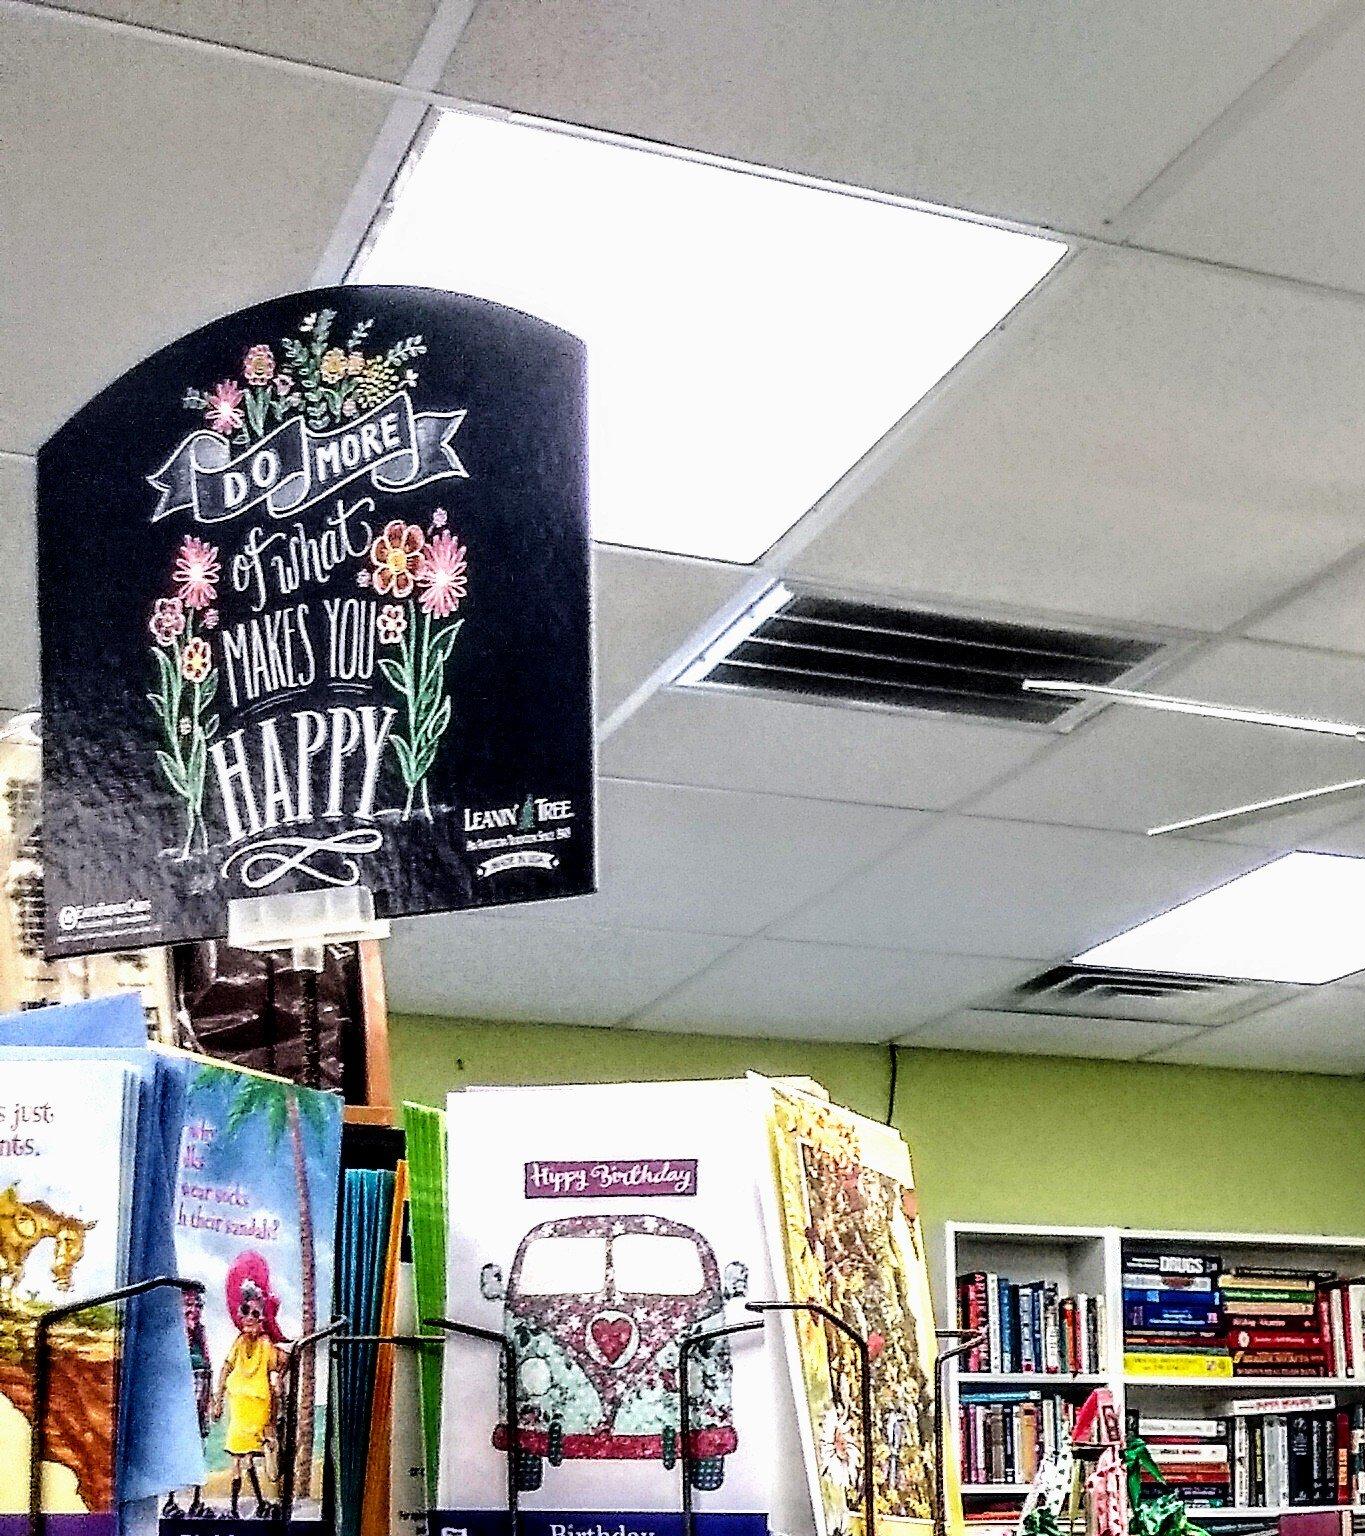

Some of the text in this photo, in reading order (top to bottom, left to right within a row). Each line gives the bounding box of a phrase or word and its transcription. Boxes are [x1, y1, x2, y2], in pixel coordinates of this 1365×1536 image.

[224, 413, 400, 508] DO MORE
[232, 497, 376, 611] of what
[222, 598, 375, 706] MAKES YOU
[209, 705, 400, 845] HAPPY
[11, 1102, 54, 1131] just
[590, 1163, 693, 1194] Birthday
